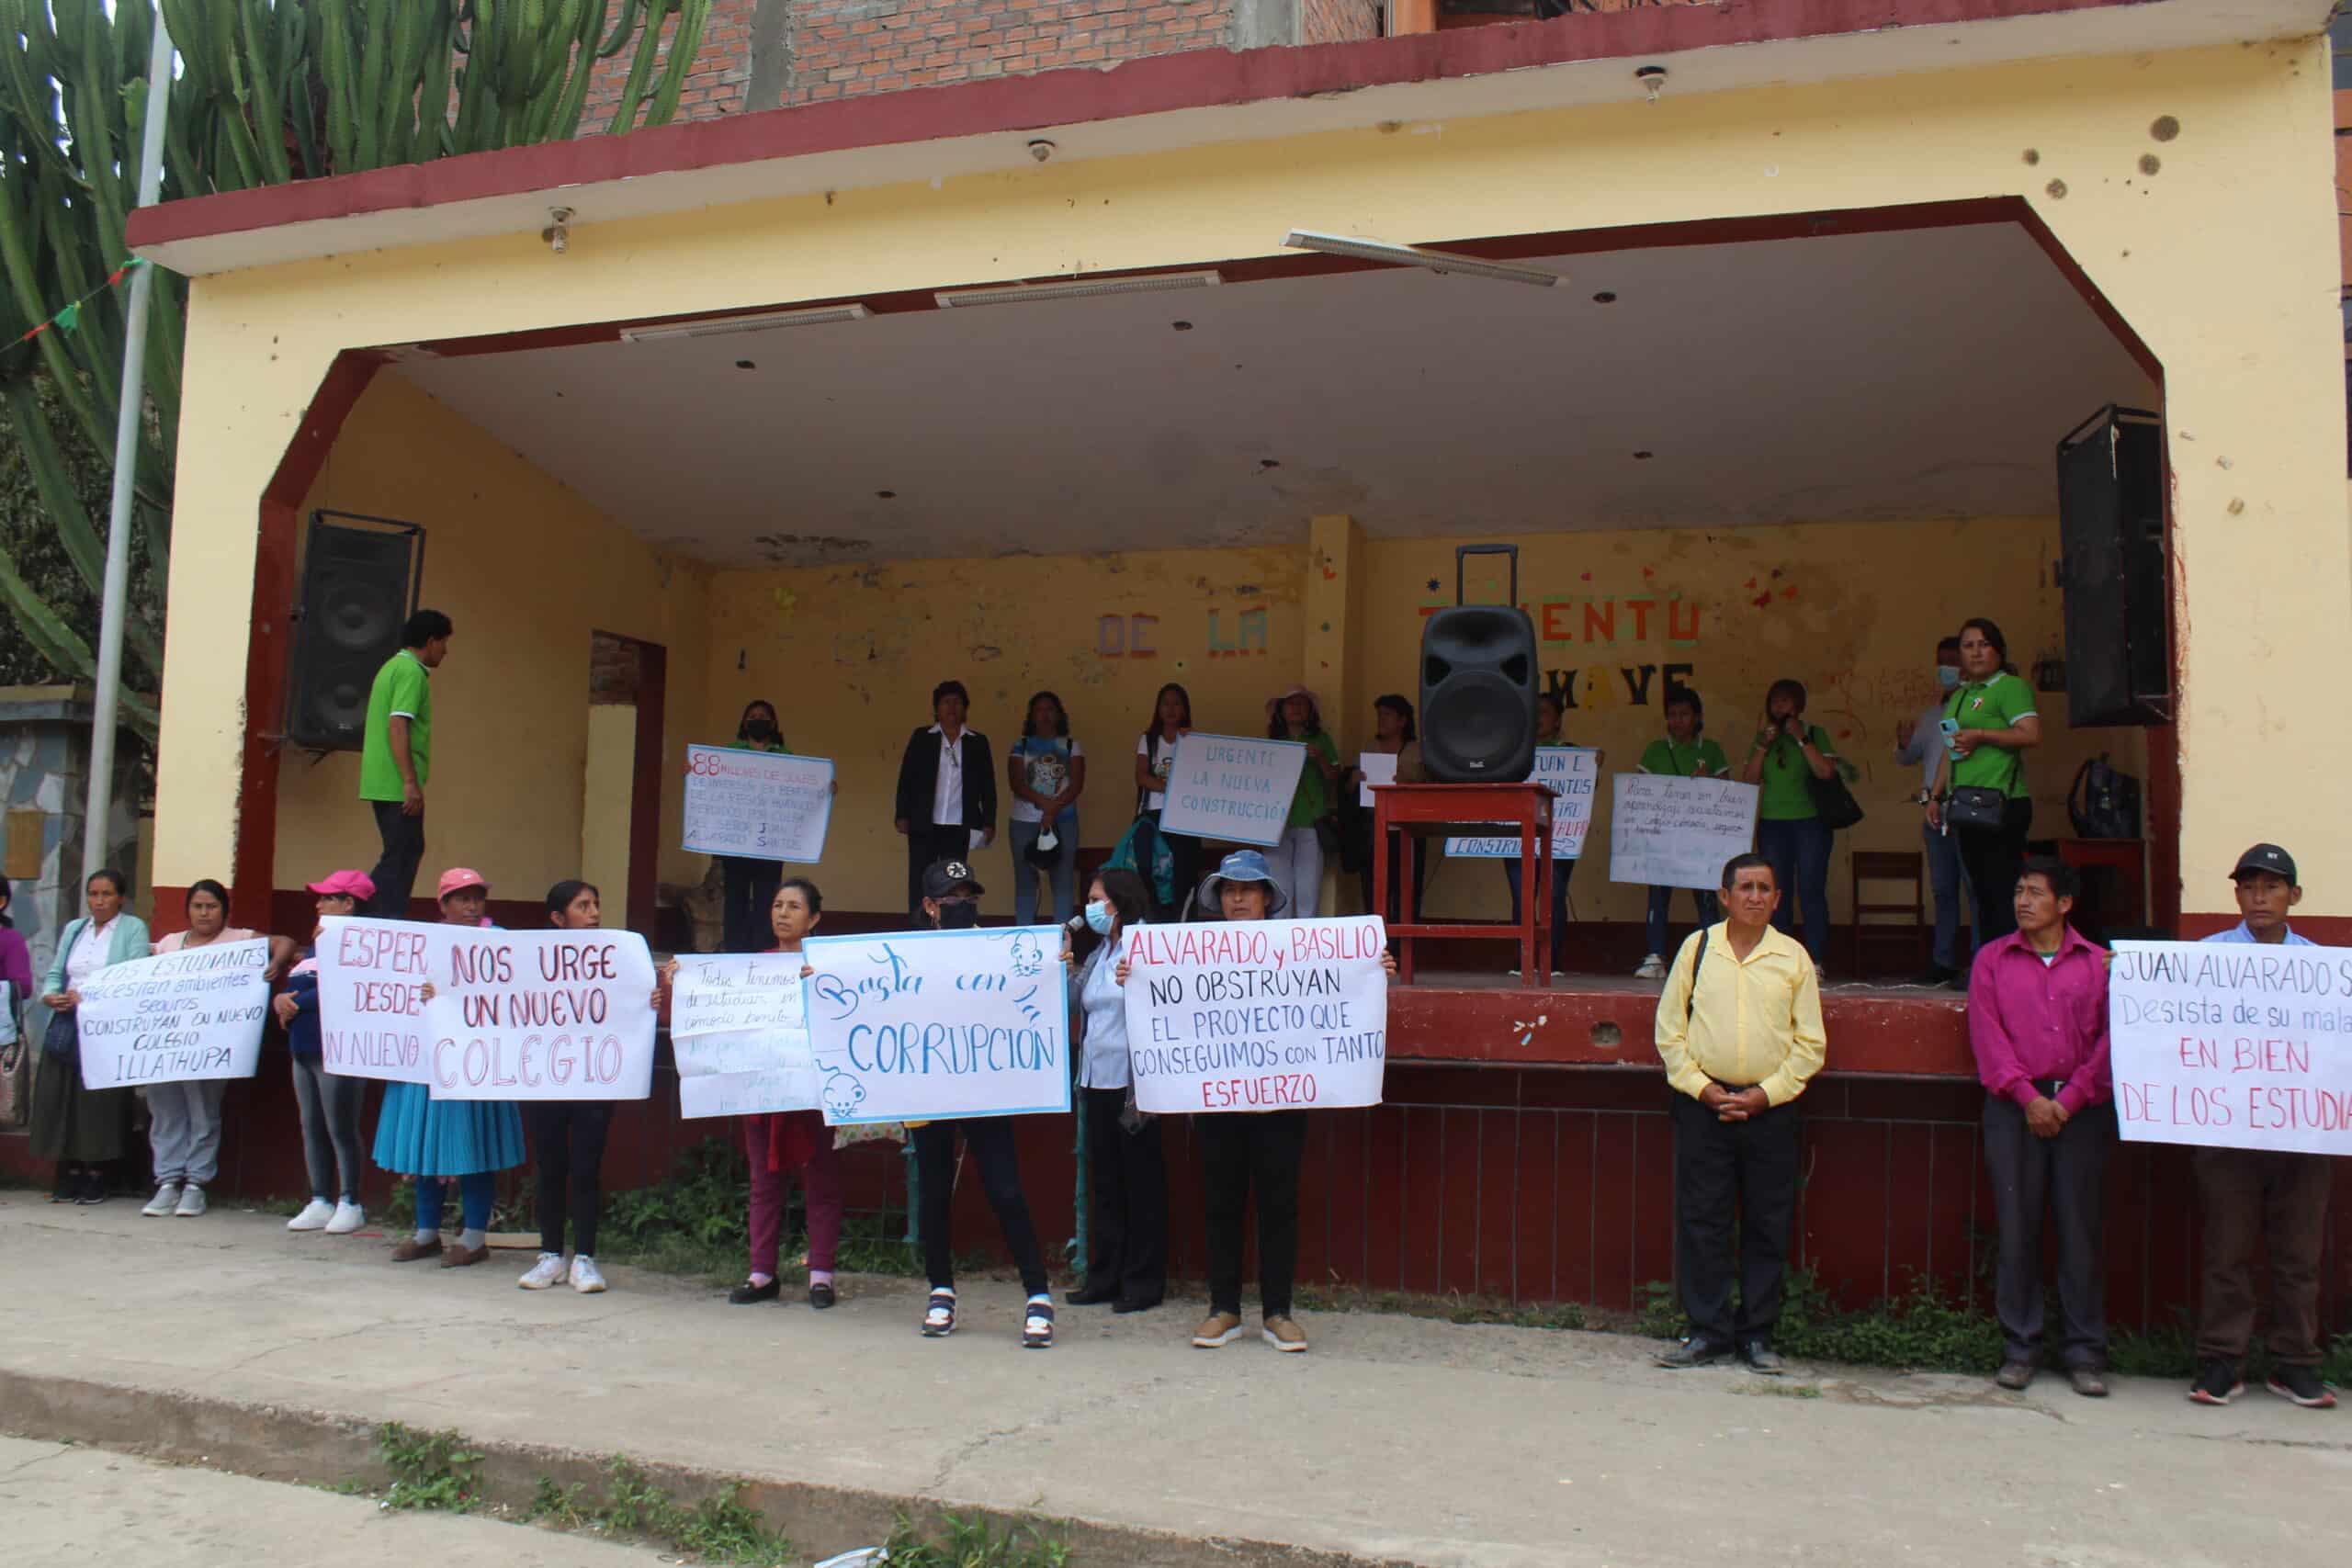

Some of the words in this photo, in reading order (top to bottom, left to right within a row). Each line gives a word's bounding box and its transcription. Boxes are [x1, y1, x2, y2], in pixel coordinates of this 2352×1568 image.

[1206, 604, 1270, 659] LA
[692, 752, 721, 776] 88
[1192, 771, 1208, 786] LA
[1221, 773, 1272, 793] NUEVA
[101, 965, 138, 981] LOS
[153, 946, 266, 976] ESTUDIANTES
[451, 944, 514, 987] NOS
[538, 943, 617, 982] URGE
[1128, 930, 1268, 966] ALVARADO
[1273, 948, 1285, 971] y
[1291, 924, 1379, 963] BASILIO
[81, 979, 169, 1001] necesitan
[175, 973, 250, 992] ambientes
[698, 961, 735, 987] Todos
[745, 959, 797, 986] tenemos
[815, 942, 923, 1021] Basta
[956, 973, 1007, 992] con
[1149, 975, 1183, 1008] NO
[1195, 967, 1341, 1003] OBSTRUYAN
[2120, 950, 2188, 984] JUAN
[2195, 954, 2332, 996] ALVARADO
[138, 998, 198, 1014] seguros
[353, 982, 421, 1016] DESDE
[463, 994, 500, 1029] UN
[510, 987, 608, 1030] NUEVO
[686, 989, 698, 1009] de
[2119, 993, 2222, 1026] Desista
[2233, 996, 2260, 1024] de
[2267, 1006, 2290, 1028] su
[2302, 1007, 2352, 1035] mala
[84, 1013, 181, 1036] CONSTRUYAN
[217, 1006, 264, 1023] NUEVO
[1152, 1016, 1180, 1043] EL
[1193, 1005, 1305, 1040] PROYECTO
[1310, 1001, 1352, 1030] QUE
[133, 1032, 199, 1052] COLEGIO
[348, 1030, 420, 1067] NUEVO
[848, 1021, 1055, 1075] CORRUPCIÓN
[1133, 1040, 1279, 1077] CONSEGUIMOS
[1321, 1029, 1385, 1065] TANTO
[2179, 1037, 2218, 1069] EN
[2232, 1037, 2309, 1073] BIEN
[115, 1047, 232, 1081] ILLATHUPA
[434, 1034, 624, 1089] COLEGIO
[1202, 1073, 1317, 1108] ESFUERZO
[2120, 1082, 2162, 1122] DE
[2172, 1085, 2233, 1126] LOS
